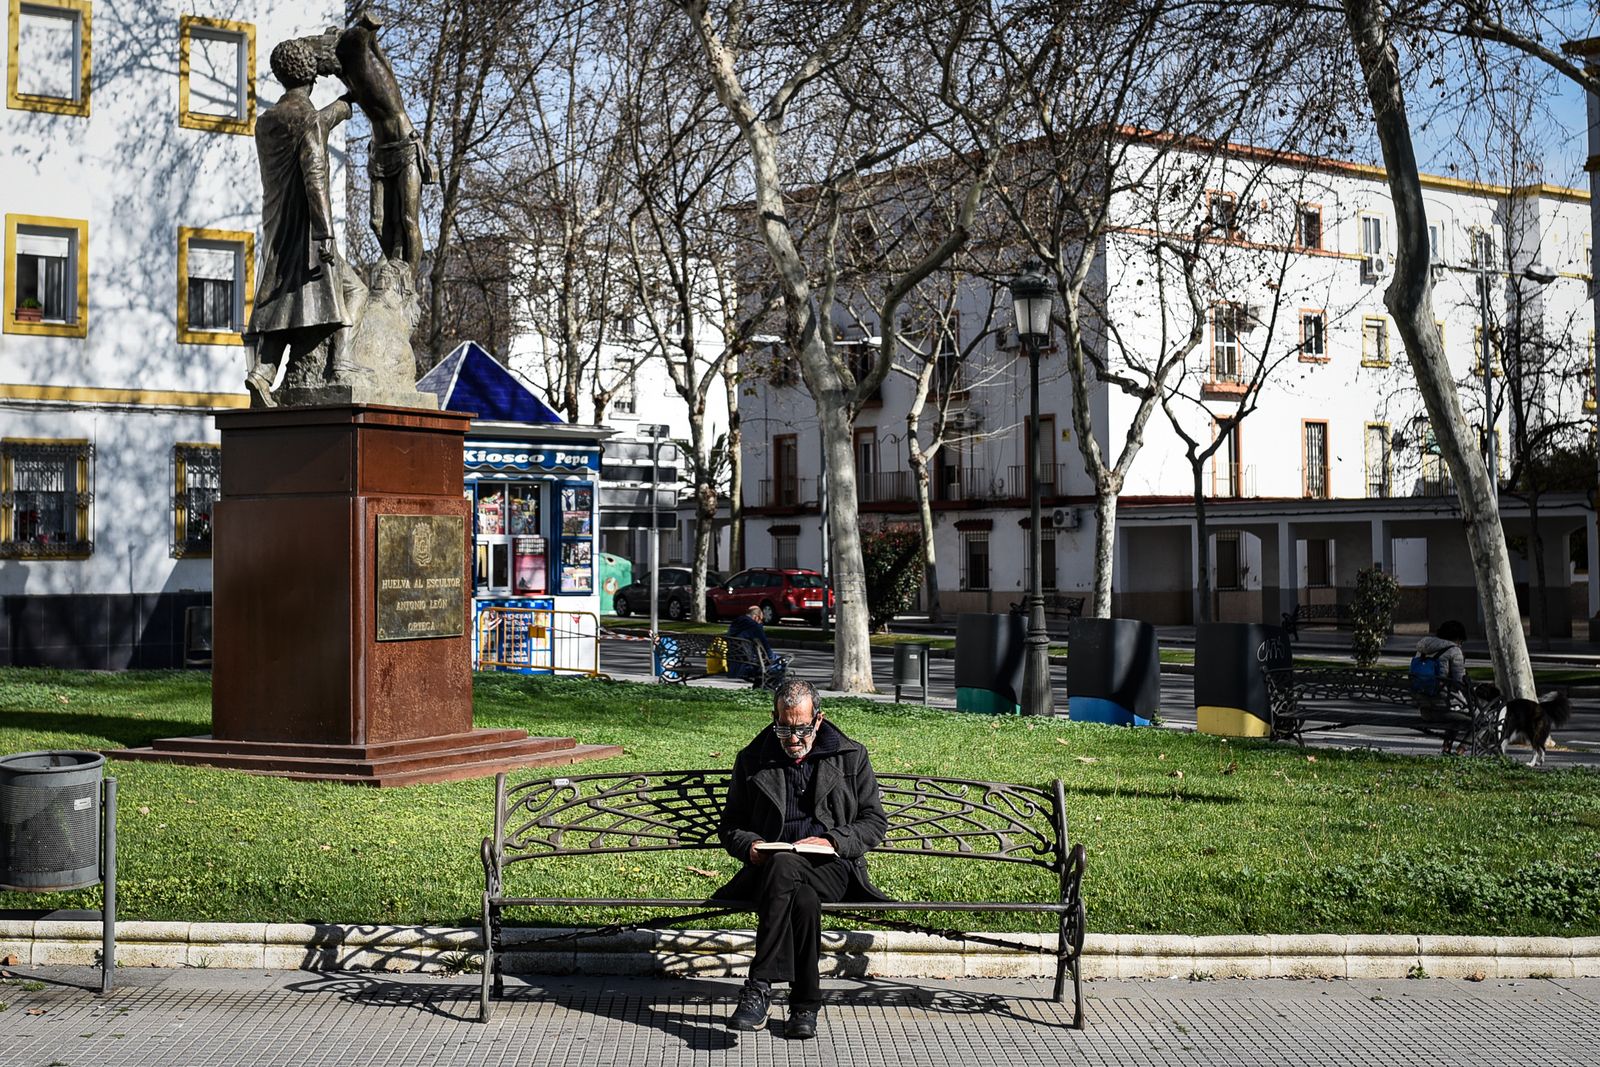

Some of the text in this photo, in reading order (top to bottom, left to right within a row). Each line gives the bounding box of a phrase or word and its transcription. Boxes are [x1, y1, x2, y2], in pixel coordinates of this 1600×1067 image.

[463, 450, 589, 466] Kiosco Pepa
[382, 578, 461, 589] HUELVA AL ESCULTOR
[396, 599, 448, 611] ANTONIO LEÓN
[408, 621, 435, 632] ORTEGA
